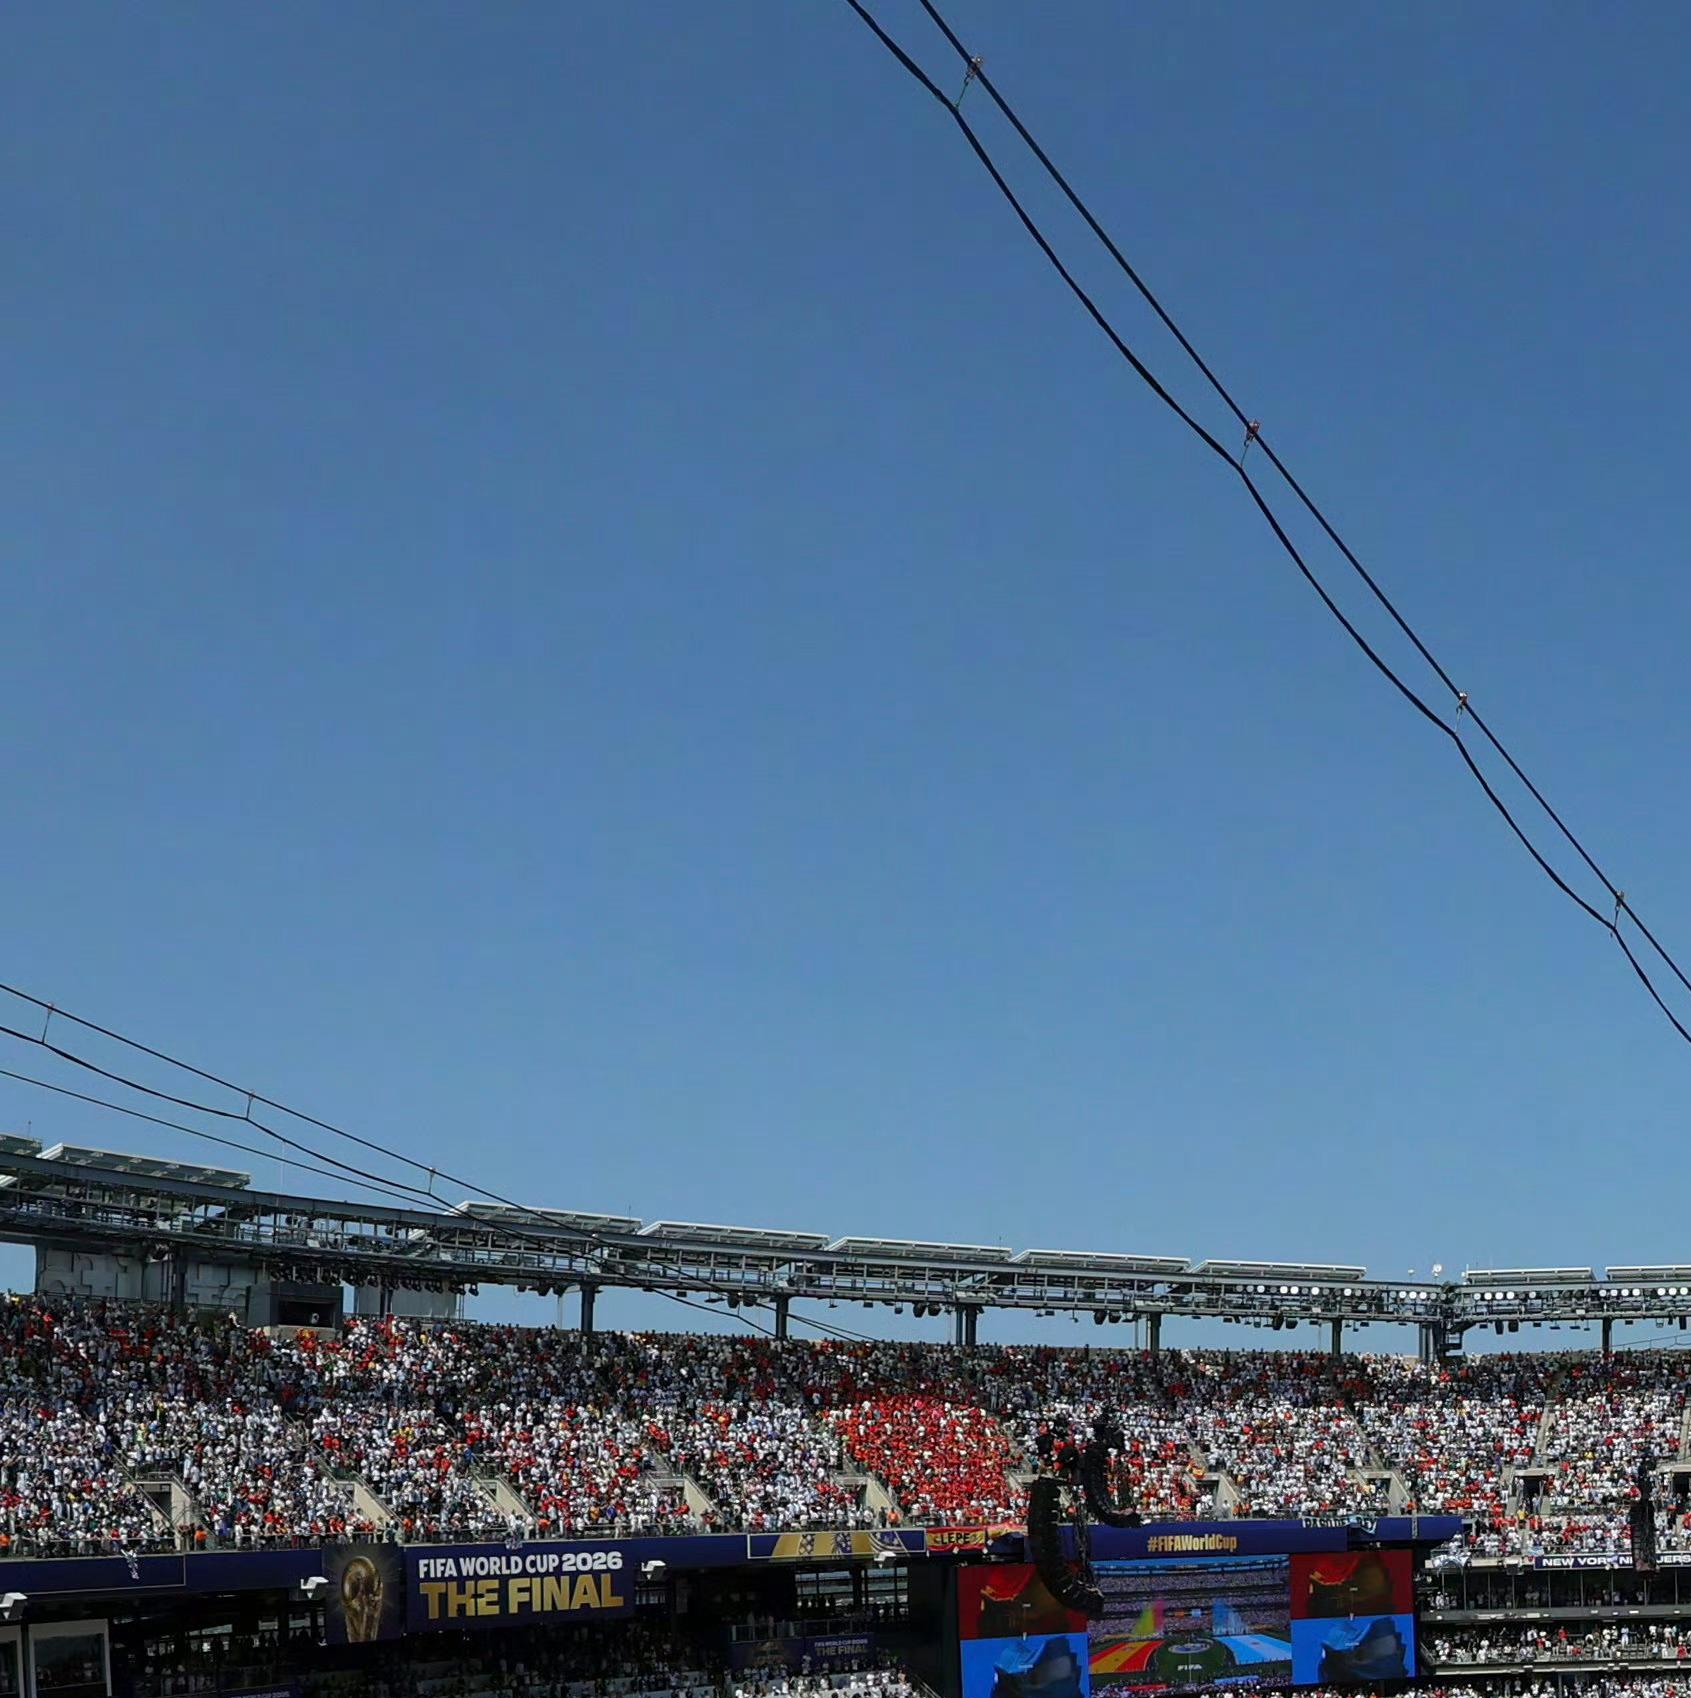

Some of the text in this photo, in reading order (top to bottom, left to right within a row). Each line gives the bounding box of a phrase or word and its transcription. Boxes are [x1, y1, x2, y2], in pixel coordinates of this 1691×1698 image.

[1146, 1533, 1239, 1552] #FIFAWorldCup
[418, 1551, 624, 1579] FIFA WORLD CUP 2026
[1542, 1556, 1575, 1567] NEW
[419, 1572, 624, 1620] THE FINAL
